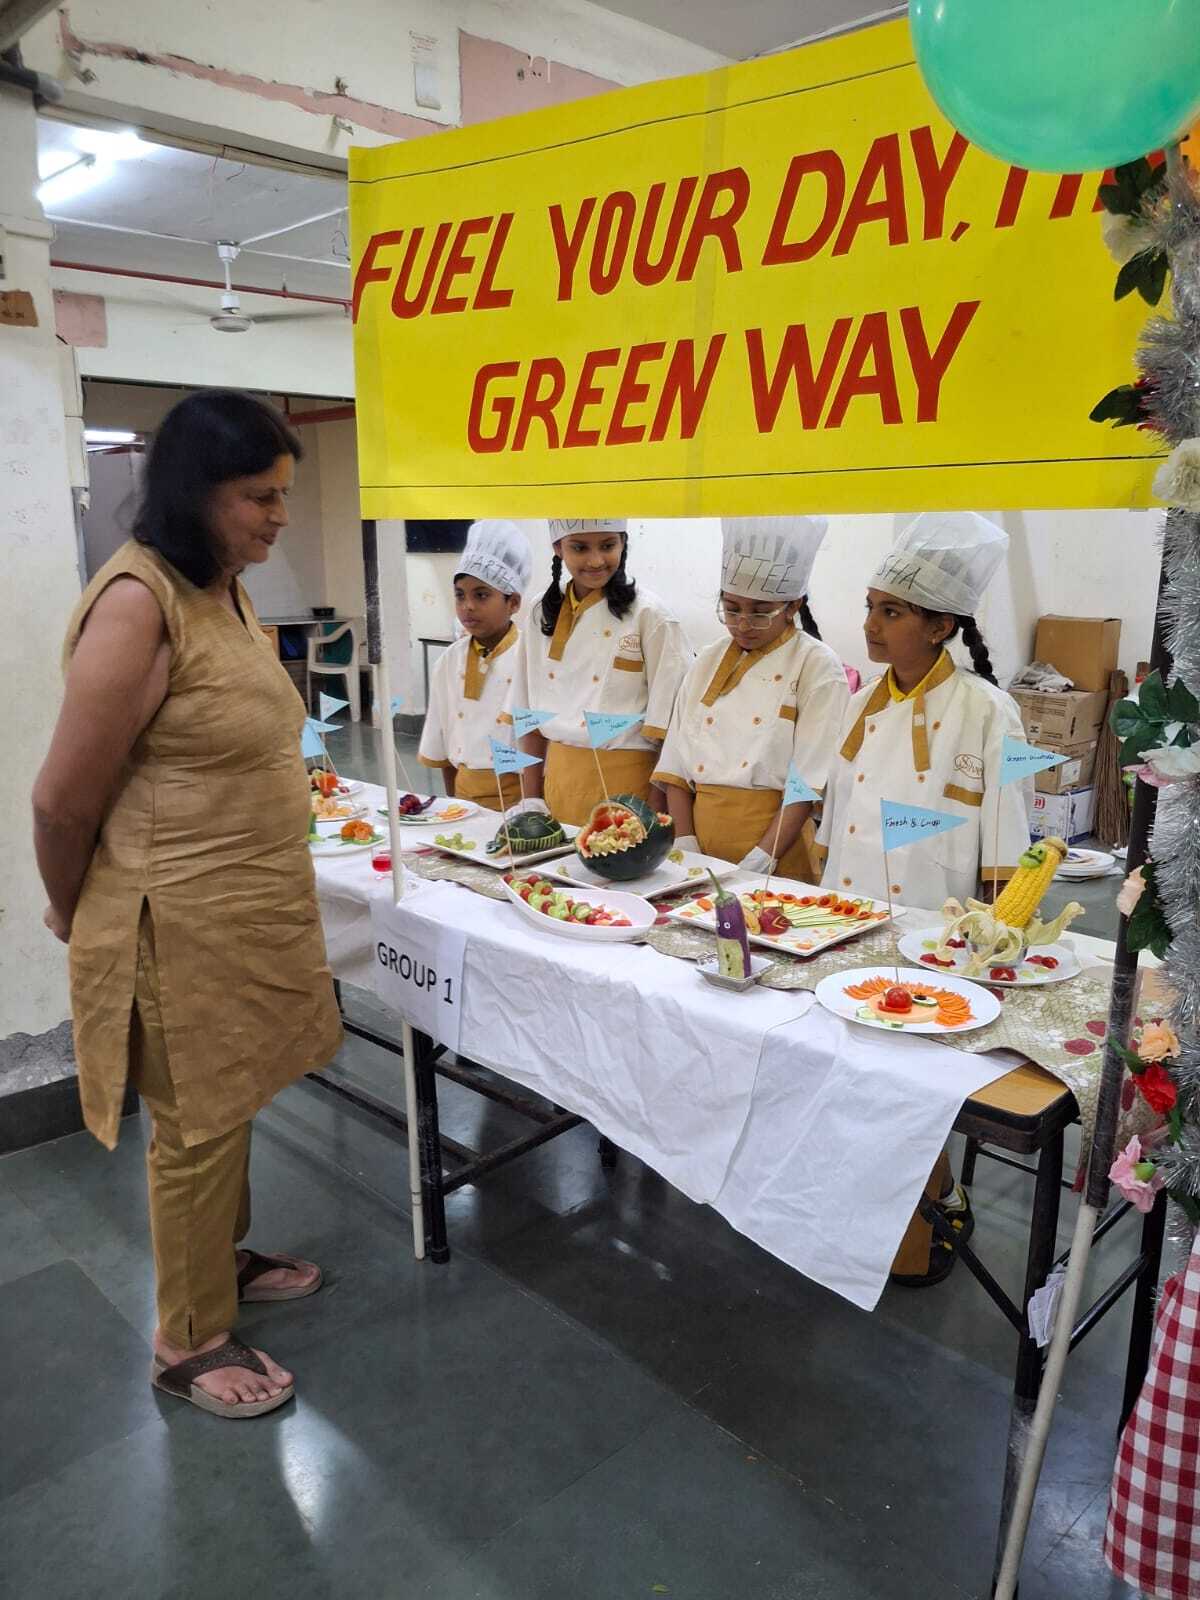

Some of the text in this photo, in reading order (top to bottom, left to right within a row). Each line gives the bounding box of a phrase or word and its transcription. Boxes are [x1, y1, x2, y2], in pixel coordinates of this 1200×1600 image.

[350, 214, 513, 323] FUEL
[549, 167, 751, 301] YOUR
[762, 126, 970, 266] DAY,
[468, 301, 981, 453] GREEN WAY
[377, 942, 454, 1005] GROUP 1
